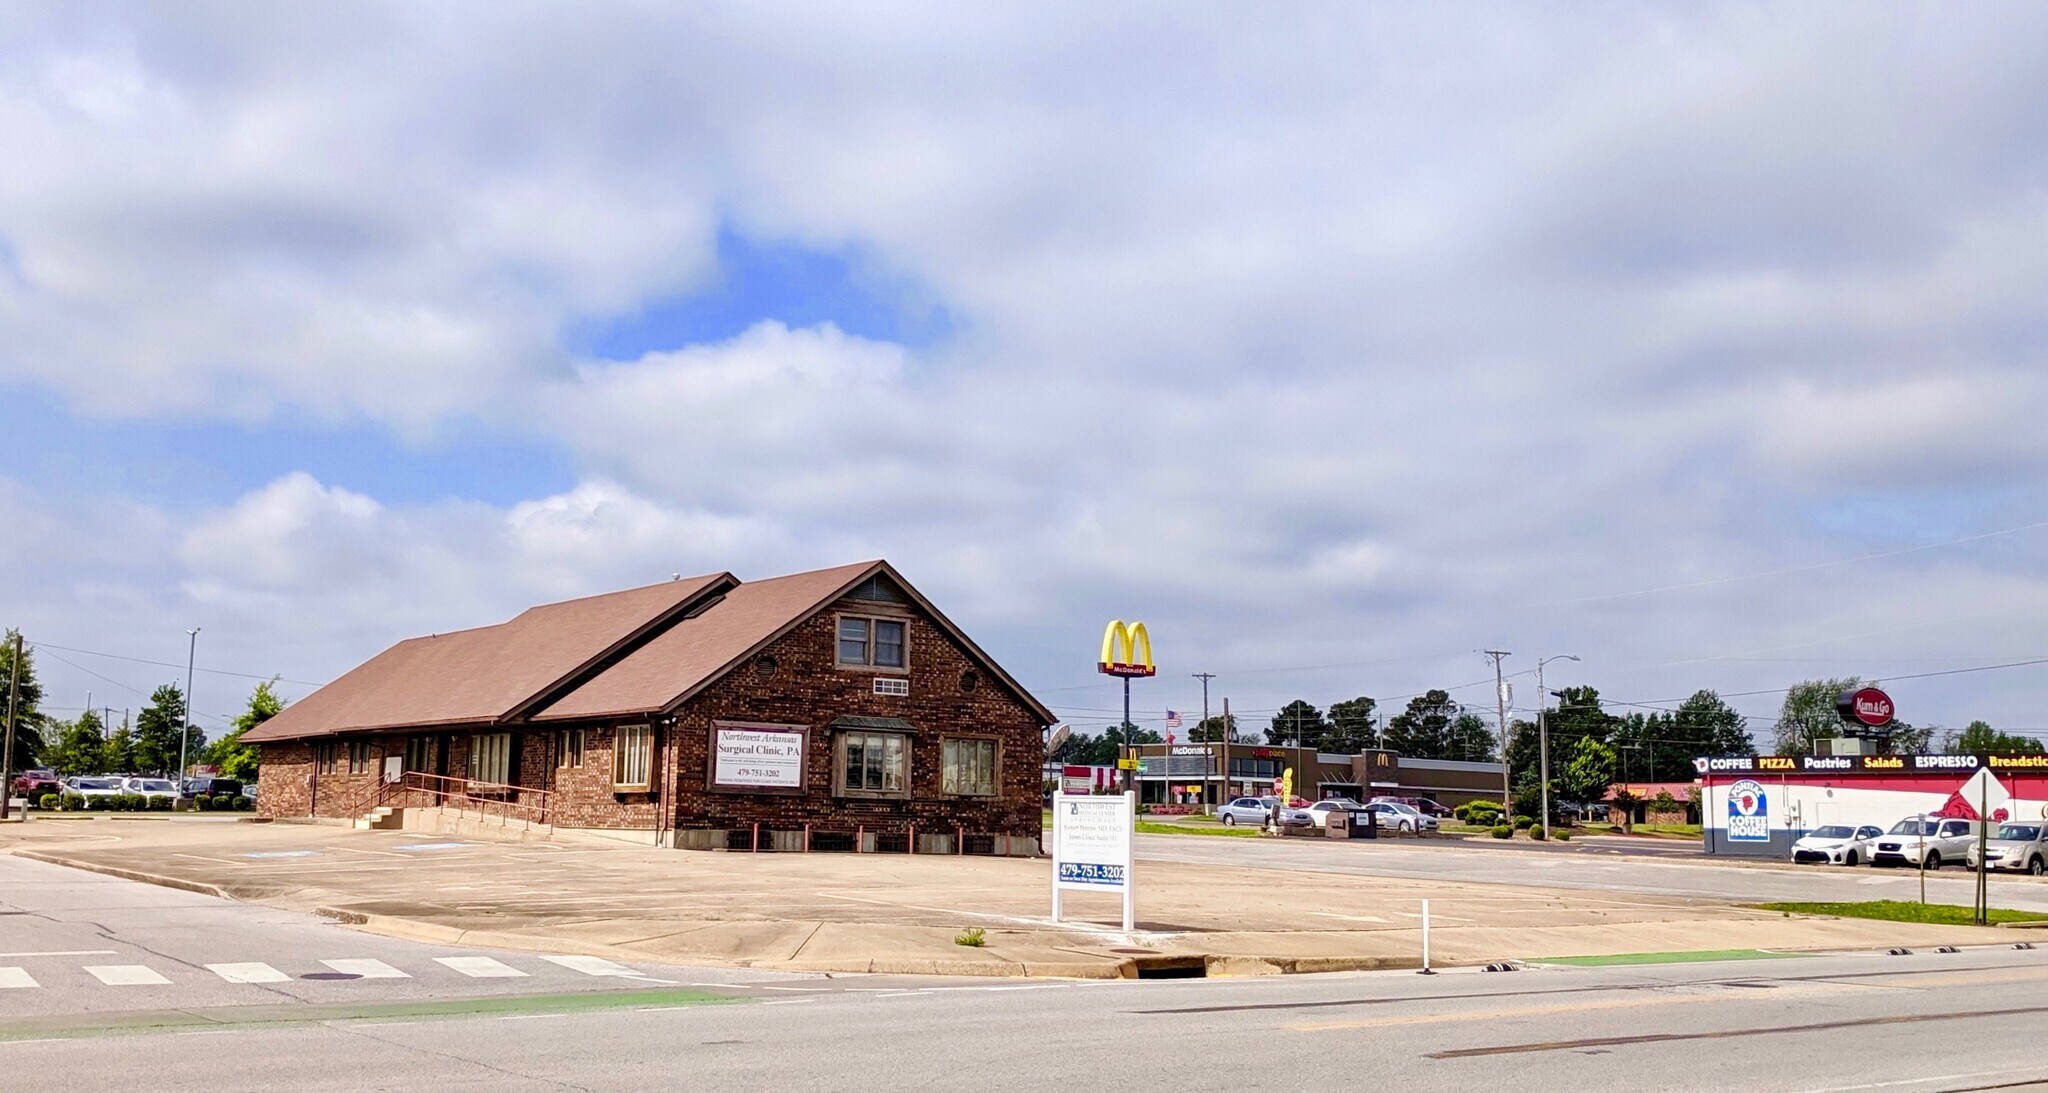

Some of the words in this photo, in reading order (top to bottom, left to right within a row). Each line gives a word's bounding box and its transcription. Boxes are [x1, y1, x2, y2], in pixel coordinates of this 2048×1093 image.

[1113, 666, 1147, 675] McDonald's
[1856, 697, 1873, 711] Kum
[1873, 701, 1879, 712] &
[1879, 700, 1890, 715] Go
[721, 731, 761, 742] Northwest
[761, 733, 797, 744] Arkansas
[718, 744, 754, 756] Surgical
[756, 744, 784, 756] Clinic,
[787, 746, 800, 756] PA
[1172, 746, 1212, 755] McDonalds
[1710, 758, 1753, 770] COFFEE
[1759, 758, 1796, 769] PIZZA
[1804, 757, 1852, 769] Pastries
[1864, 757, 1904, 768] Salads
[1915, 756, 1978, 768] ESPRESSO
[737, 768, 780, 778] 479-751-3202
[1731, 782, 1763, 798] PONTIAC
[1729, 815, 1767, 827] COFFEE
[1730, 826, 1767, 837] HOUSE
[1060, 864, 1124, 878] 479-751-3202
